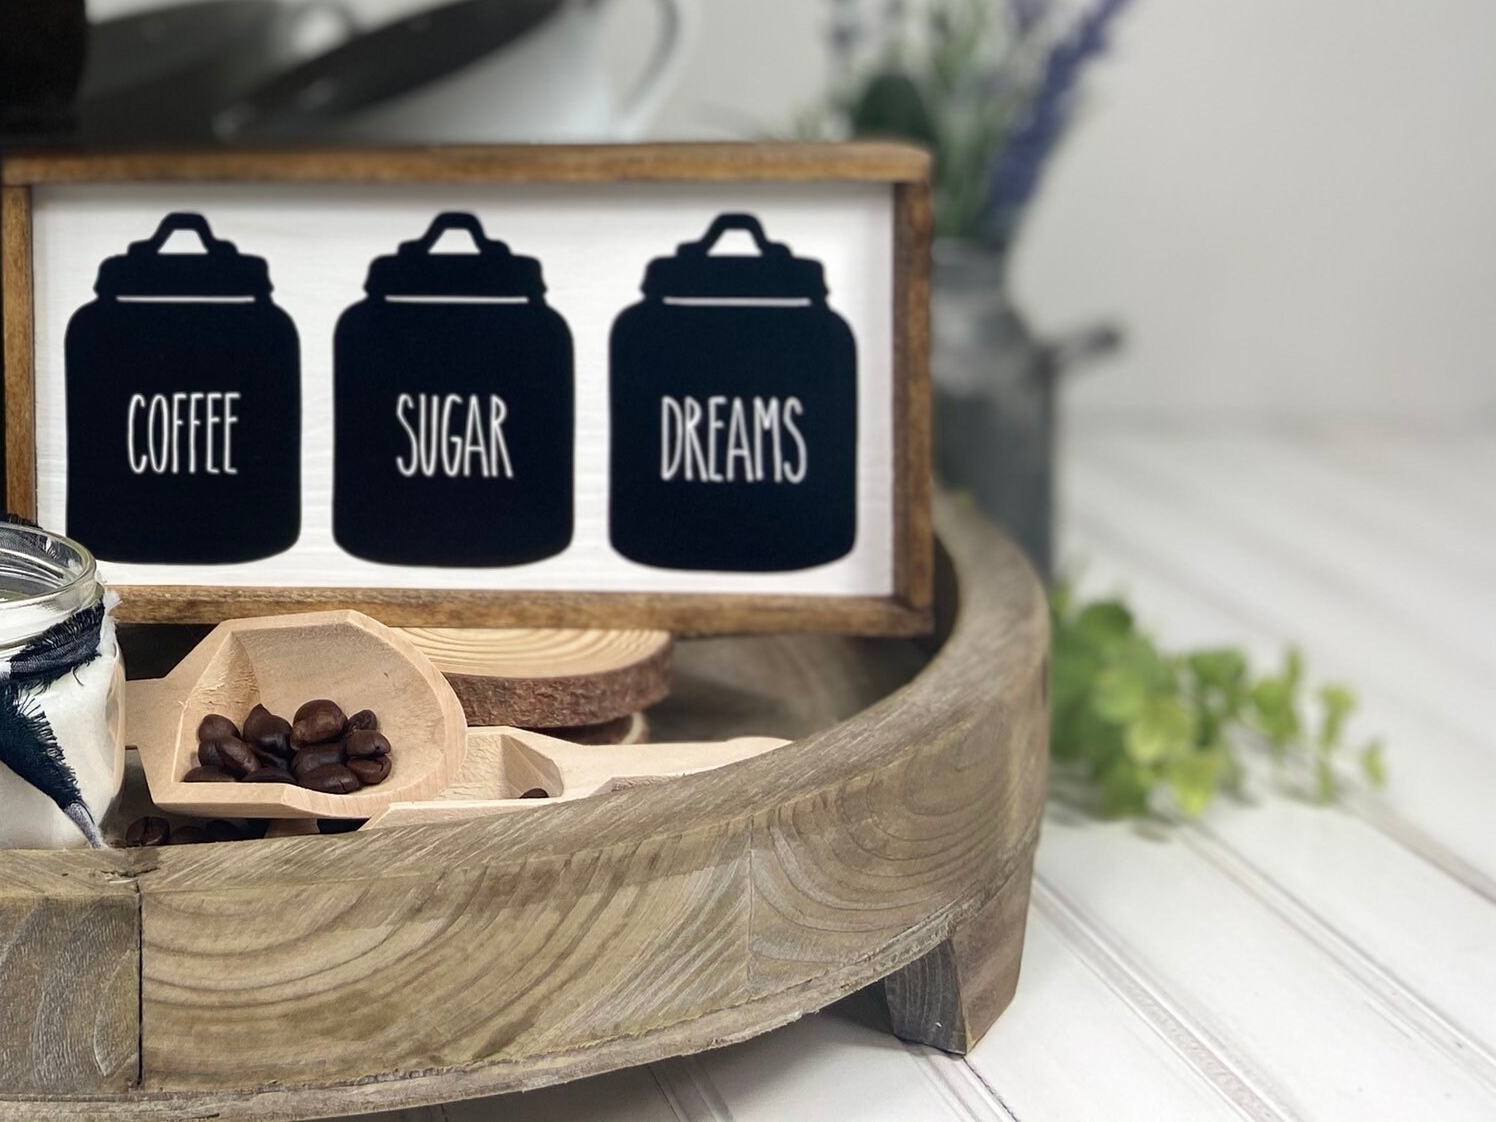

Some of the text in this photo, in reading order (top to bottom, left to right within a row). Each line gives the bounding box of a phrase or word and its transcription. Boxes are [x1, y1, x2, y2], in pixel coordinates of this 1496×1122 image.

[126, 391, 242, 476] COFFEE
[395, 393, 514, 479] SUGAR
[660, 394, 809, 484] DREAMS
